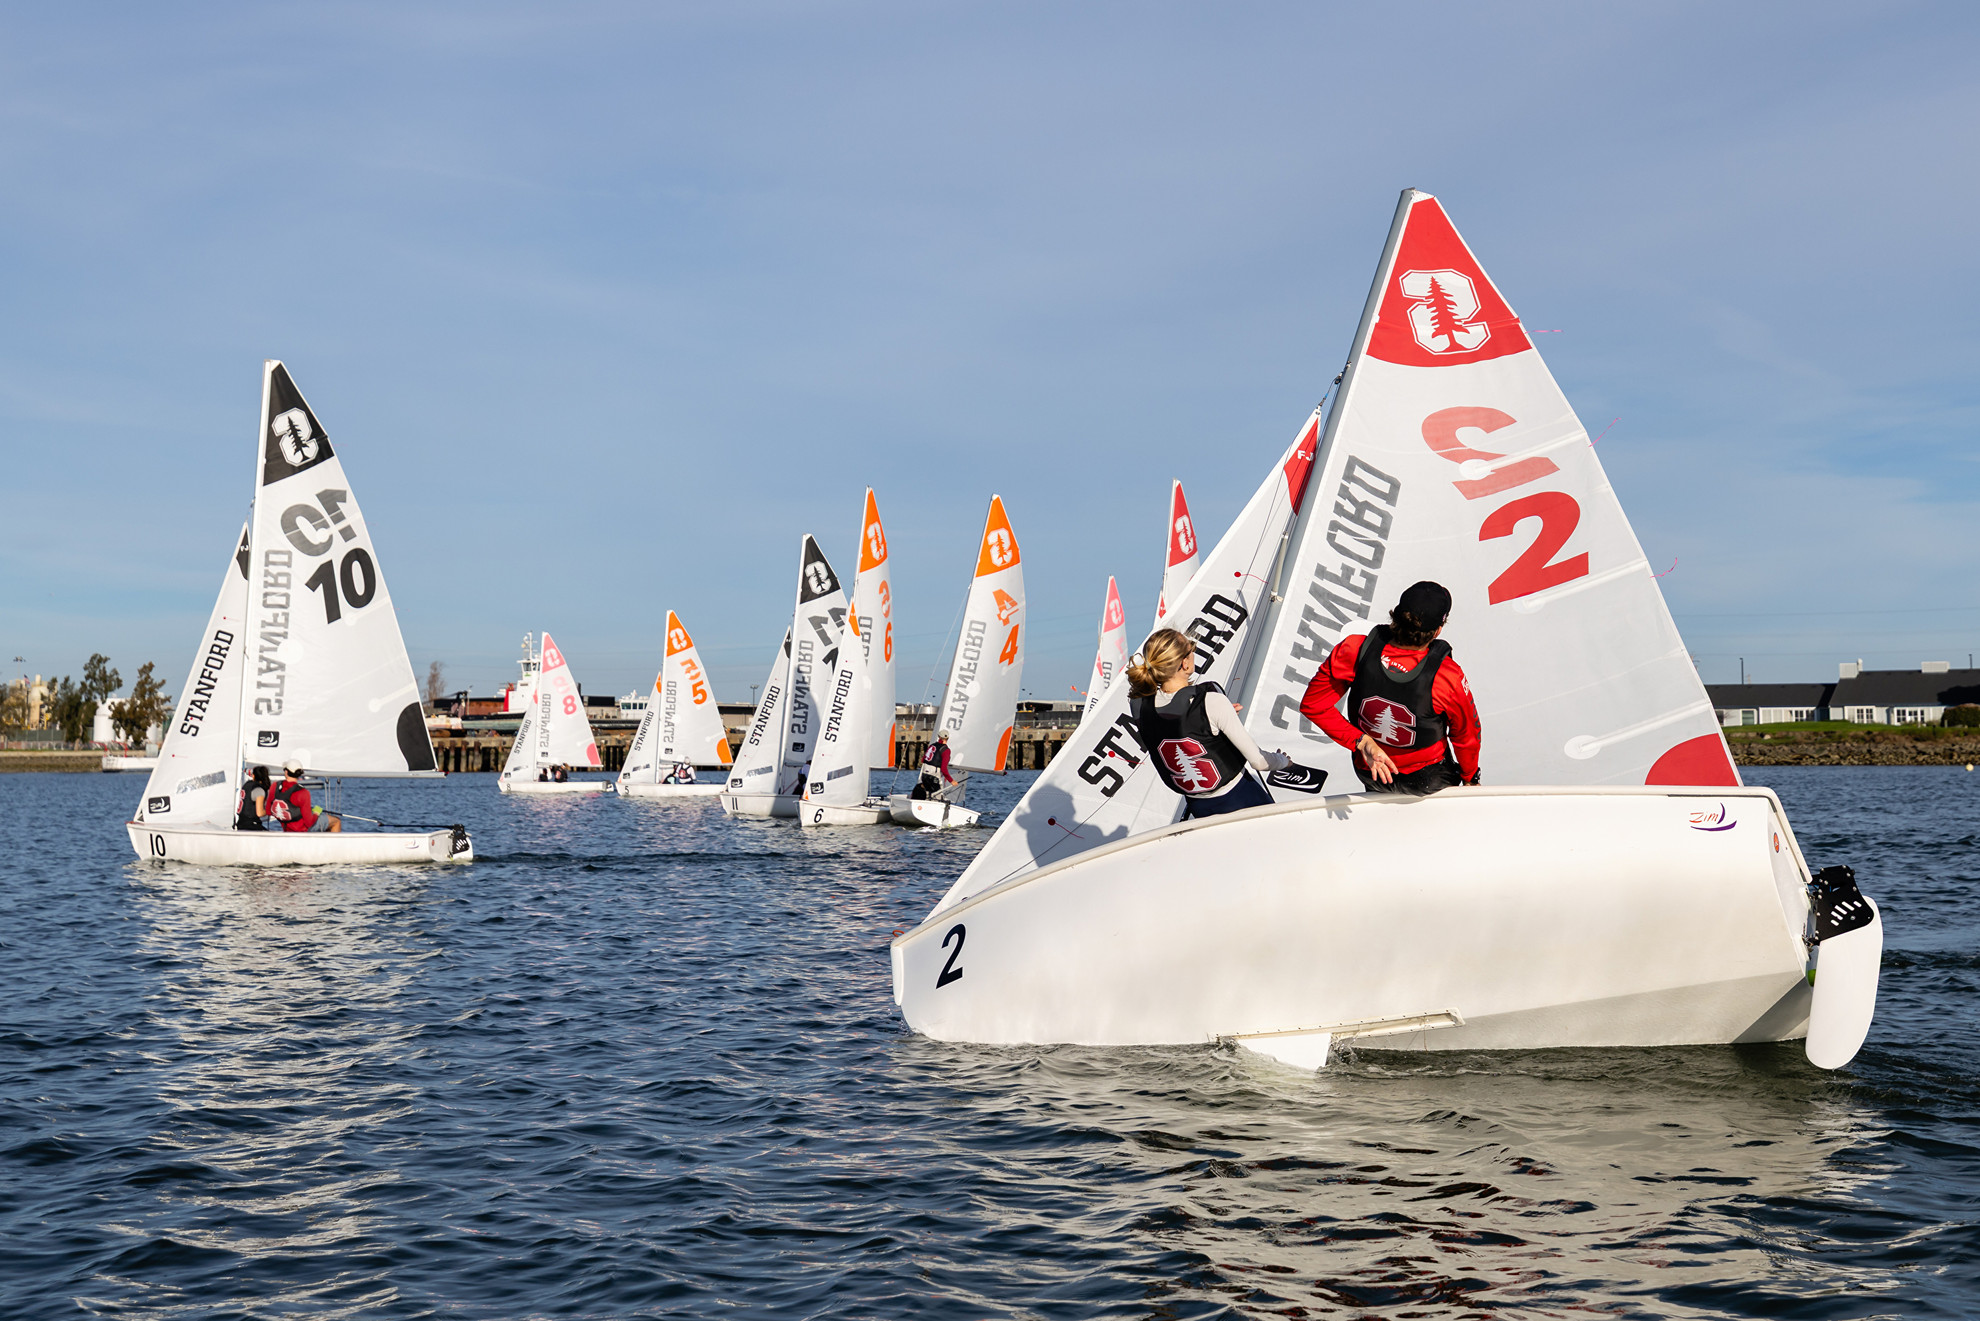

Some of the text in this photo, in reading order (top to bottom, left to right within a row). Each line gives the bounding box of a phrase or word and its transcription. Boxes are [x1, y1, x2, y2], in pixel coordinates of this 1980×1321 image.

[1297, 450, 1314, 461] FJ
[1478, 490, 1590, 605] 2
[305, 547, 377, 624] 10
[884, 621, 893, 663] 6
[998, 623, 1020, 666] 4
[180, 629, 234, 737] STANFORD
[692, 680, 707, 705] 5
[1077, 593, 1248, 798] STAORD
[562, 695, 577, 715] 8
[749, 685, 781, 746] STANFORD
[824, 669, 854, 743] STANFORD
[514, 719, 532, 754] STANFORD
[634, 711, 654, 751] STANFORD
[624, 785, 630, 795] 5
[731, 797, 739, 811] 11
[813, 808, 824, 824] 6
[1689, 811, 1719, 823] Zim
[150, 833, 166, 857] 10
[936, 923, 967, 989] 2
